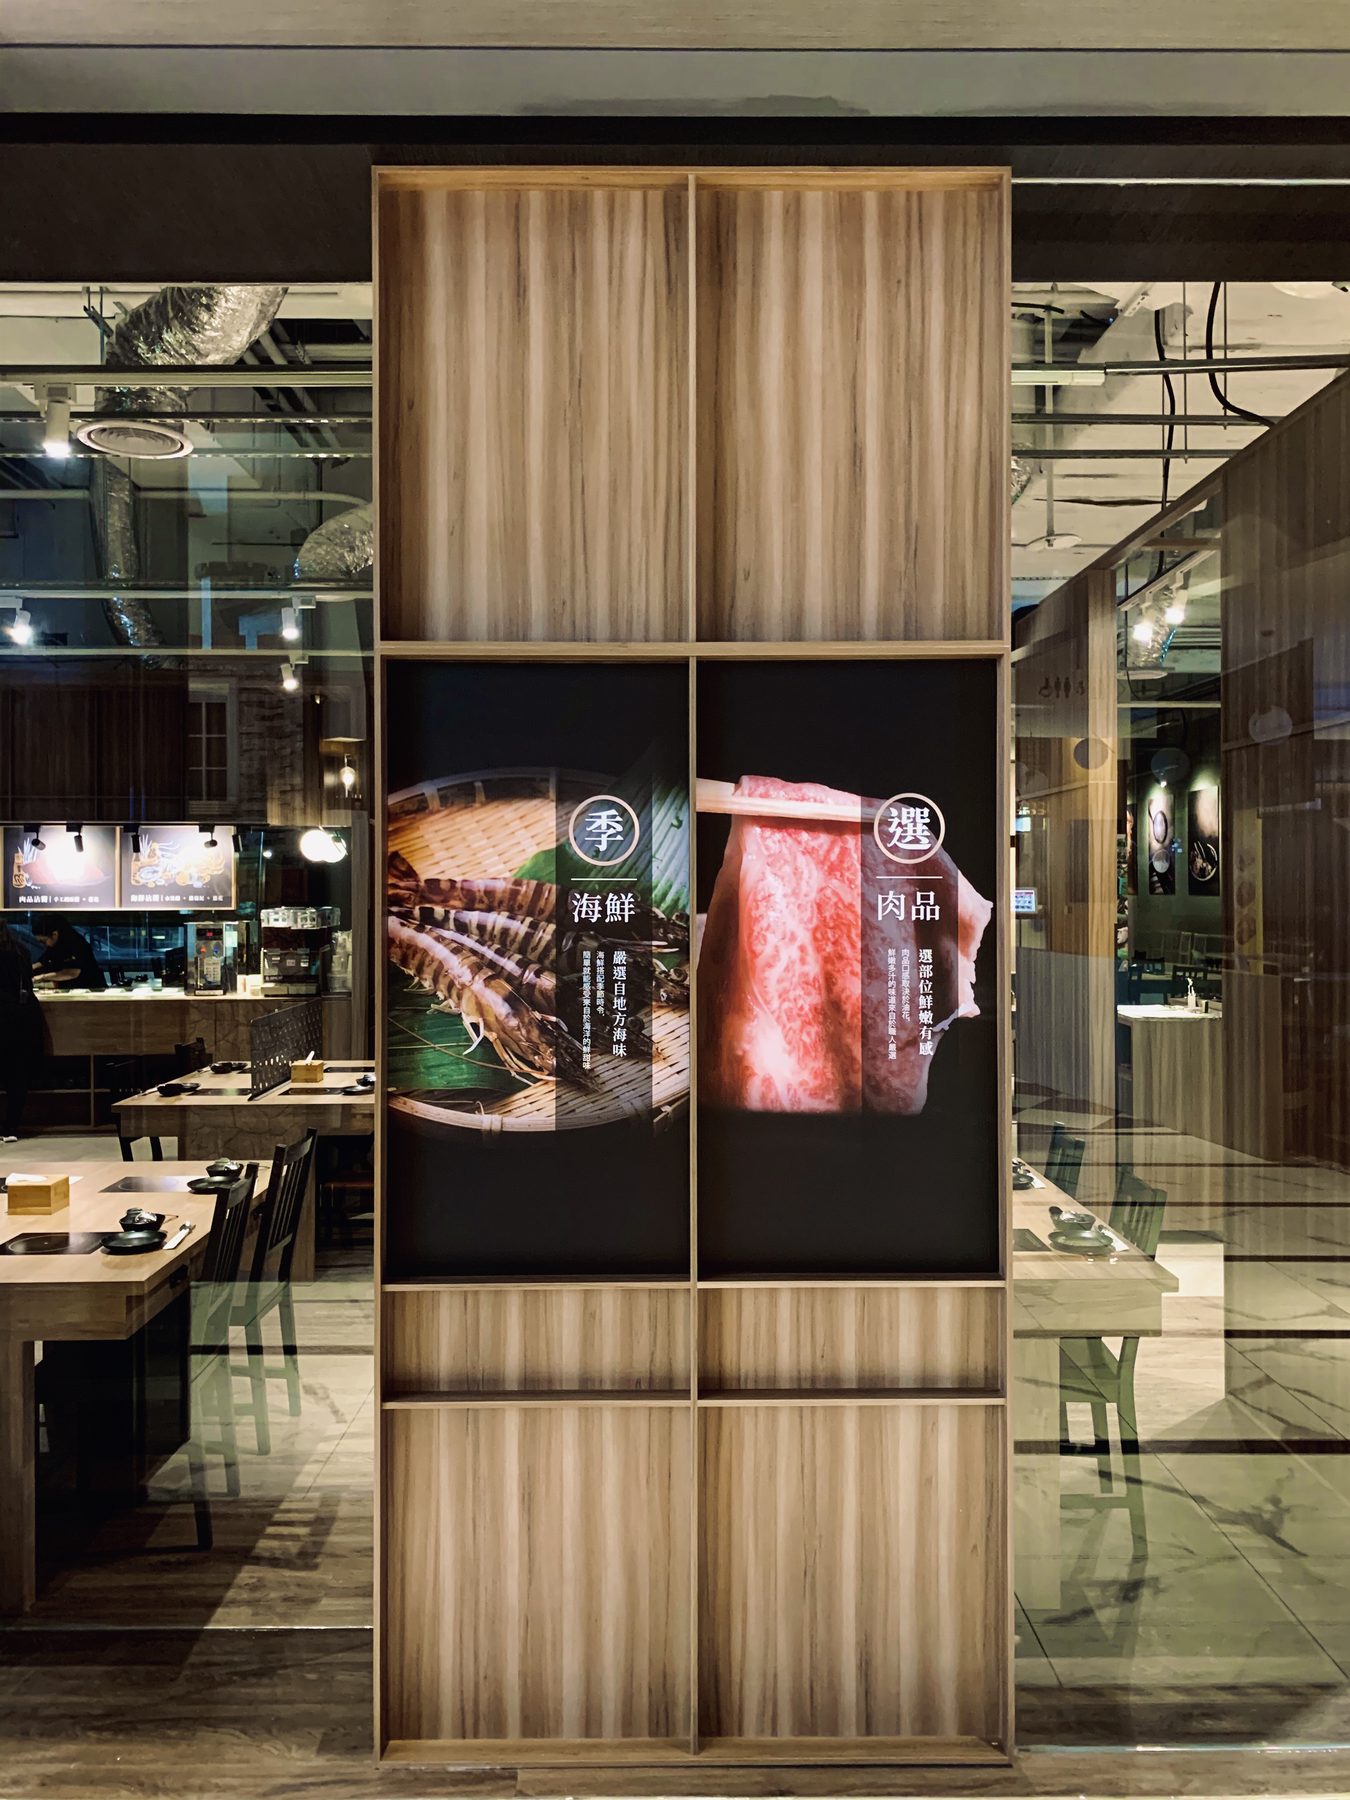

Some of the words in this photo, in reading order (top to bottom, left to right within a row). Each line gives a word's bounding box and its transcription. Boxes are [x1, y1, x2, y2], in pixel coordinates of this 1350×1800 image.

[584, 809, 624, 852] 季
[887, 807, 932, 850] 選
[572, 892, 636, 923] 海鮮
[877, 891, 941, 921] 肉品
[612, 950, 627, 1058] 嚴選自地方海味
[918, 948, 934, 1056] 選部位鮮嫩有感
